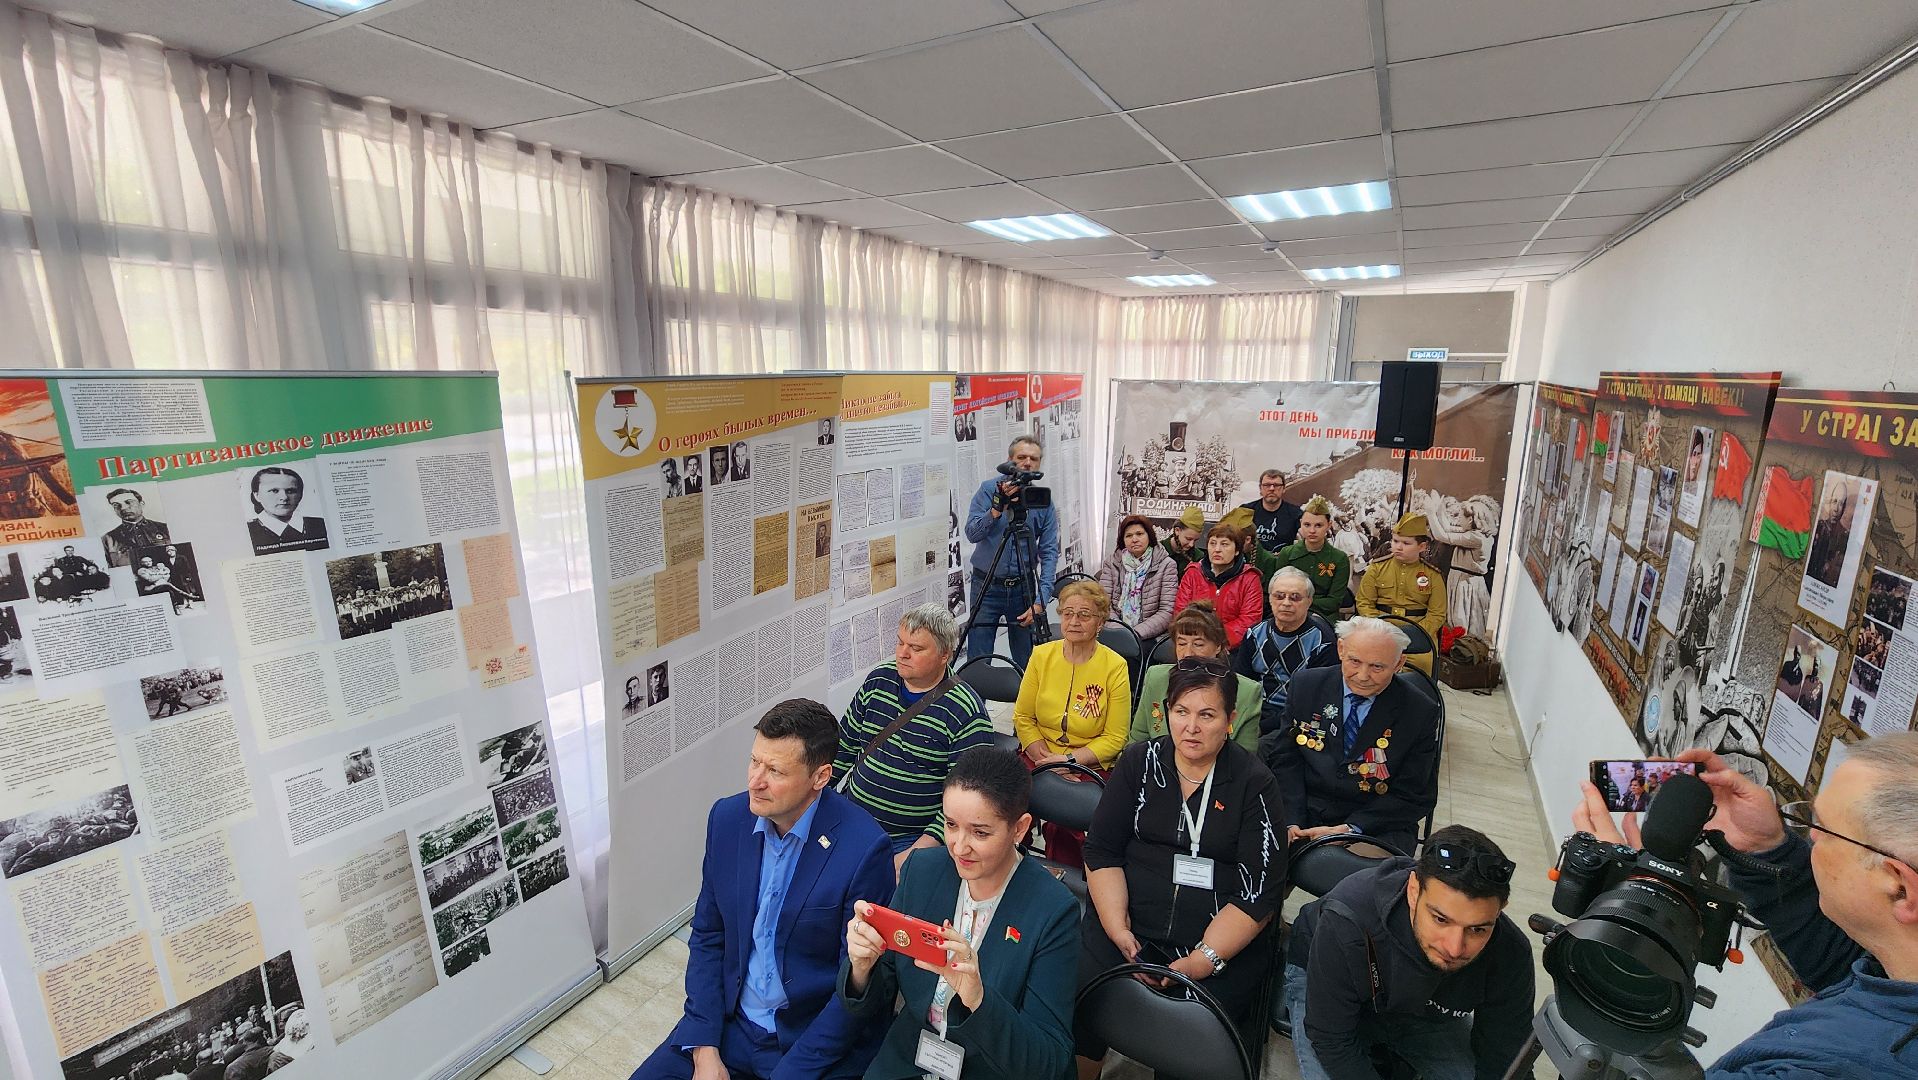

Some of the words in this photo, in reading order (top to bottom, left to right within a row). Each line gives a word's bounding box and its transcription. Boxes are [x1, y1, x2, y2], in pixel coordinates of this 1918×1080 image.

[1657, 384, 1663, 400] У
[1259, 410, 1287, 422] ЭТОТ
[1289, 411, 1319, 424] ДЕНЬ
[658, 436, 671, 452] О
[676, 427, 720, 449] героях
[723, 416, 764, 437] былых
[768, 406, 817, 427] времен...
[1299, 427, 1322, 438] МЫ
[1800, 410, 1812, 433] У
[1817, 410, 1882, 443] СТРАІ
[97, 435, 315, 479] Партизанское
[321, 418, 433, 449] движение
[1422, 447, 1485, 462] МОГЛИ!..
[5, 527, 78, 542] РОДИНУ!
[1648, 860, 1684, 877] SONY
